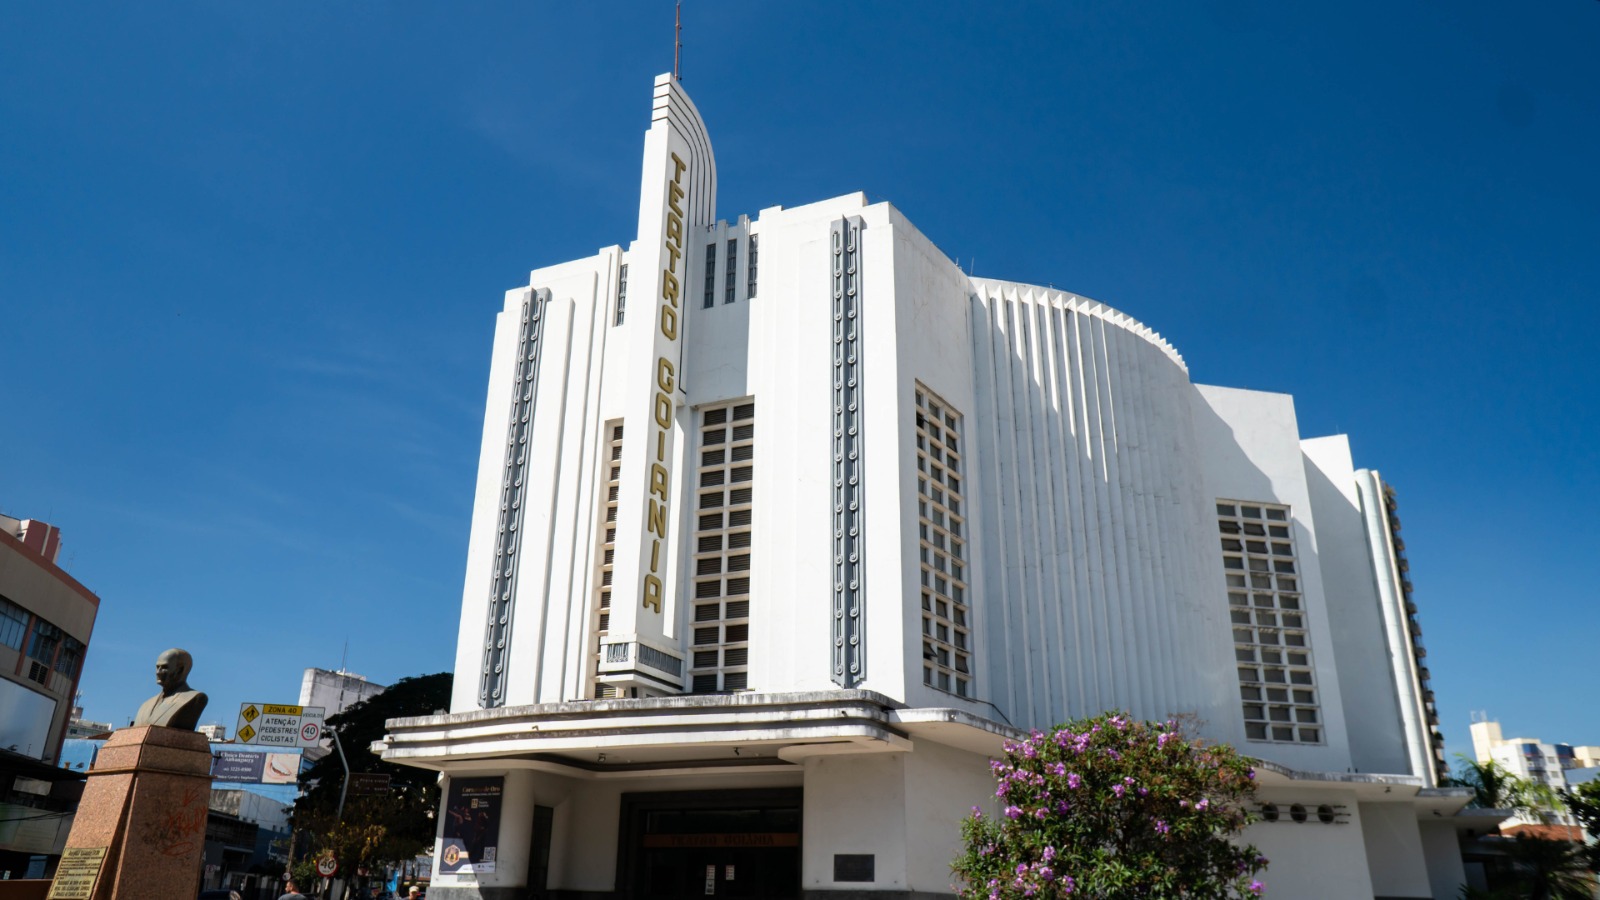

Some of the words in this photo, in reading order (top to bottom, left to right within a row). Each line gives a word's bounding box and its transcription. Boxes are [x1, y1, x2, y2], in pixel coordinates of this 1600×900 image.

[660, 151, 687, 341] TEATRO
[642, 356, 675, 614] GOIANIA
[265, 717, 297, 726] ATENÇÃO
[260, 727, 298, 735] PEDESTRES
[304, 727, 316, 735] 40
[260, 735, 294, 743] CICLISTAS
[320, 859, 335, 870] 40
